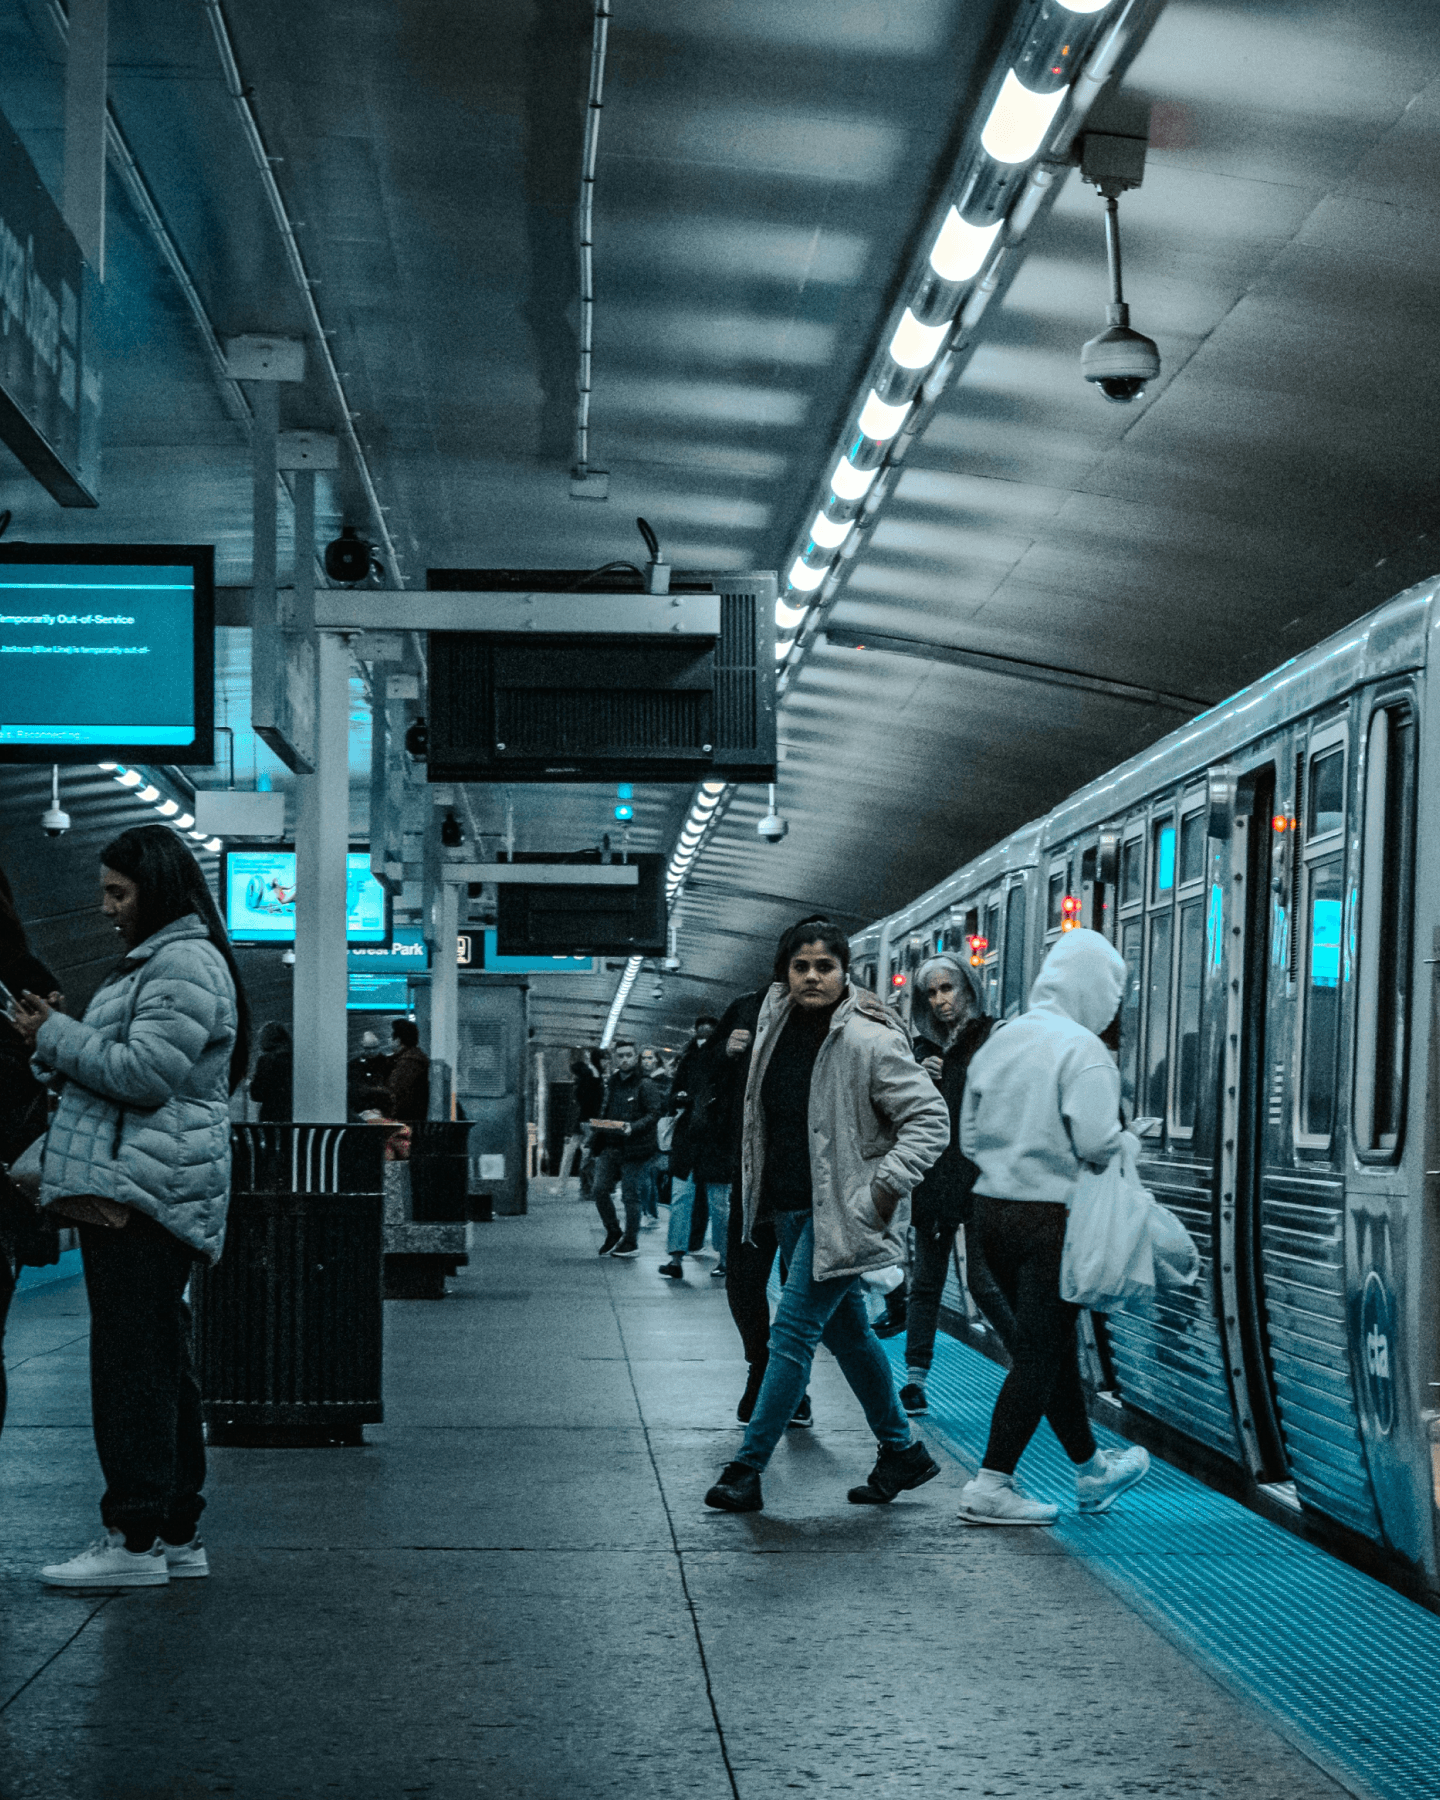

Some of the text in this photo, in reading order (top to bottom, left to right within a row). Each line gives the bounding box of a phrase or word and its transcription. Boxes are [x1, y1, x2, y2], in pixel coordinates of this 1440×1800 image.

[0, 614, 135, 625] emporarily Out-of-Service
[391, 942, 424, 956] Park
